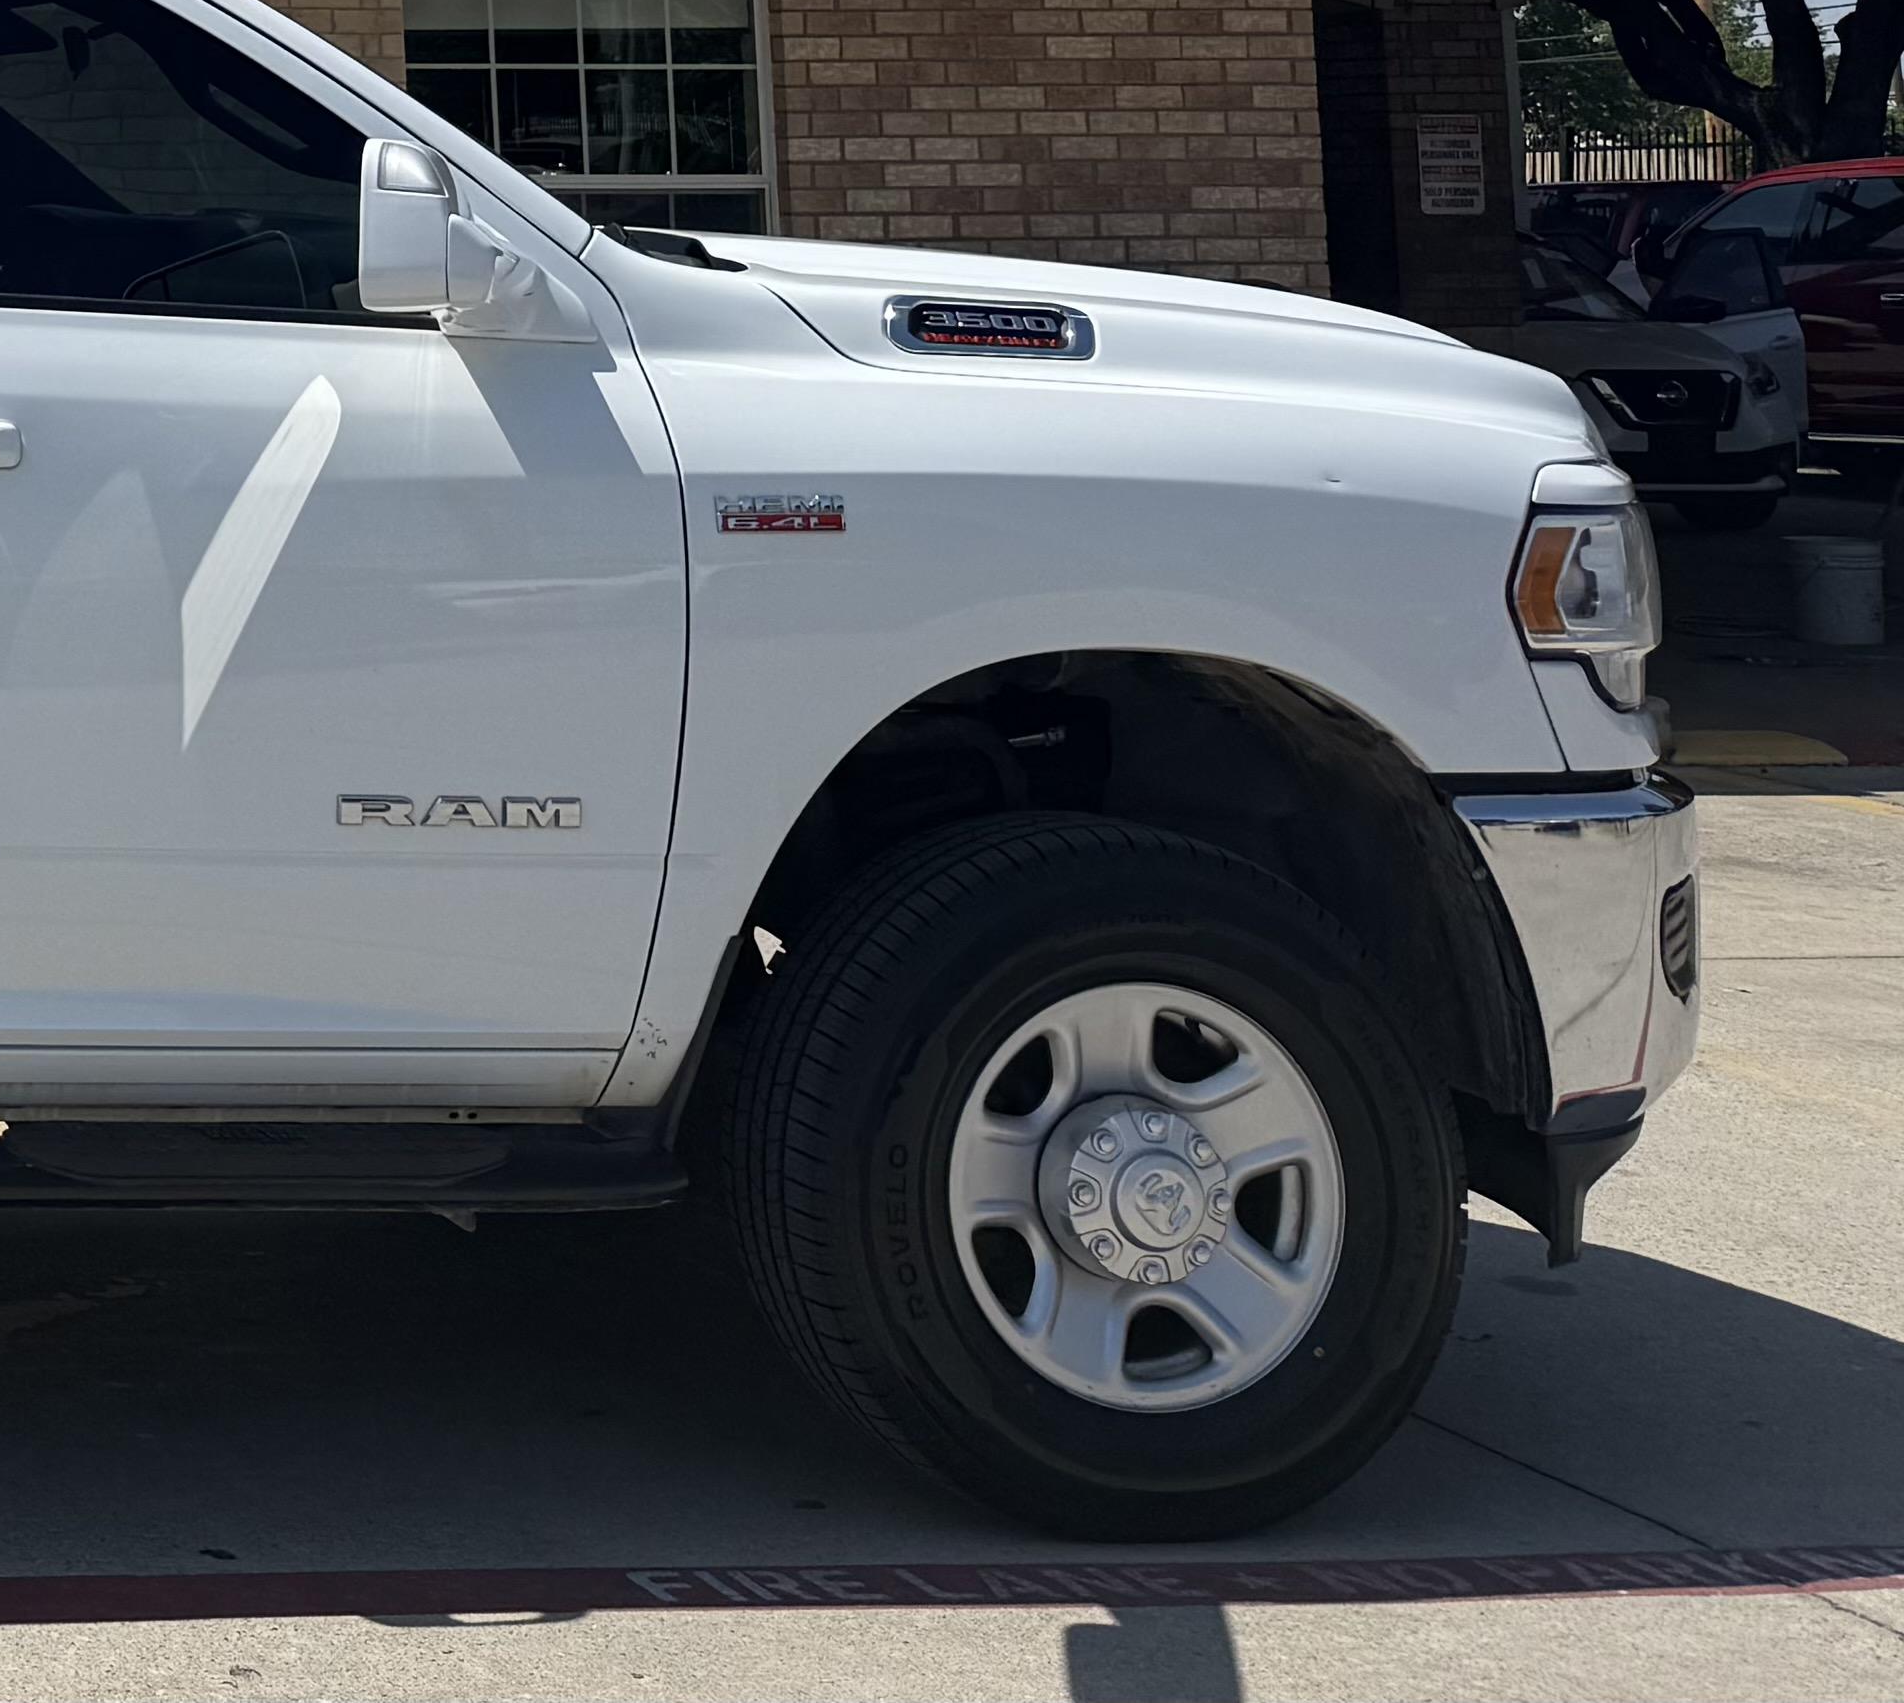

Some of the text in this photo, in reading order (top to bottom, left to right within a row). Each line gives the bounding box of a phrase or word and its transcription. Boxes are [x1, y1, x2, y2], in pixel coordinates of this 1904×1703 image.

[922, 310, 1059, 332] 3500
[714, 495, 845, 513] HEMI
[726, 516, 840, 530] 6.4L
[337, 794, 581, 828] RAM
[885, 1143, 930, 1320] ROVELO
[625, 1569, 902, 1603] FIRE
[894, 1565, 1220, 1600] LANE
[1302, 1562, 1474, 1596] NO
